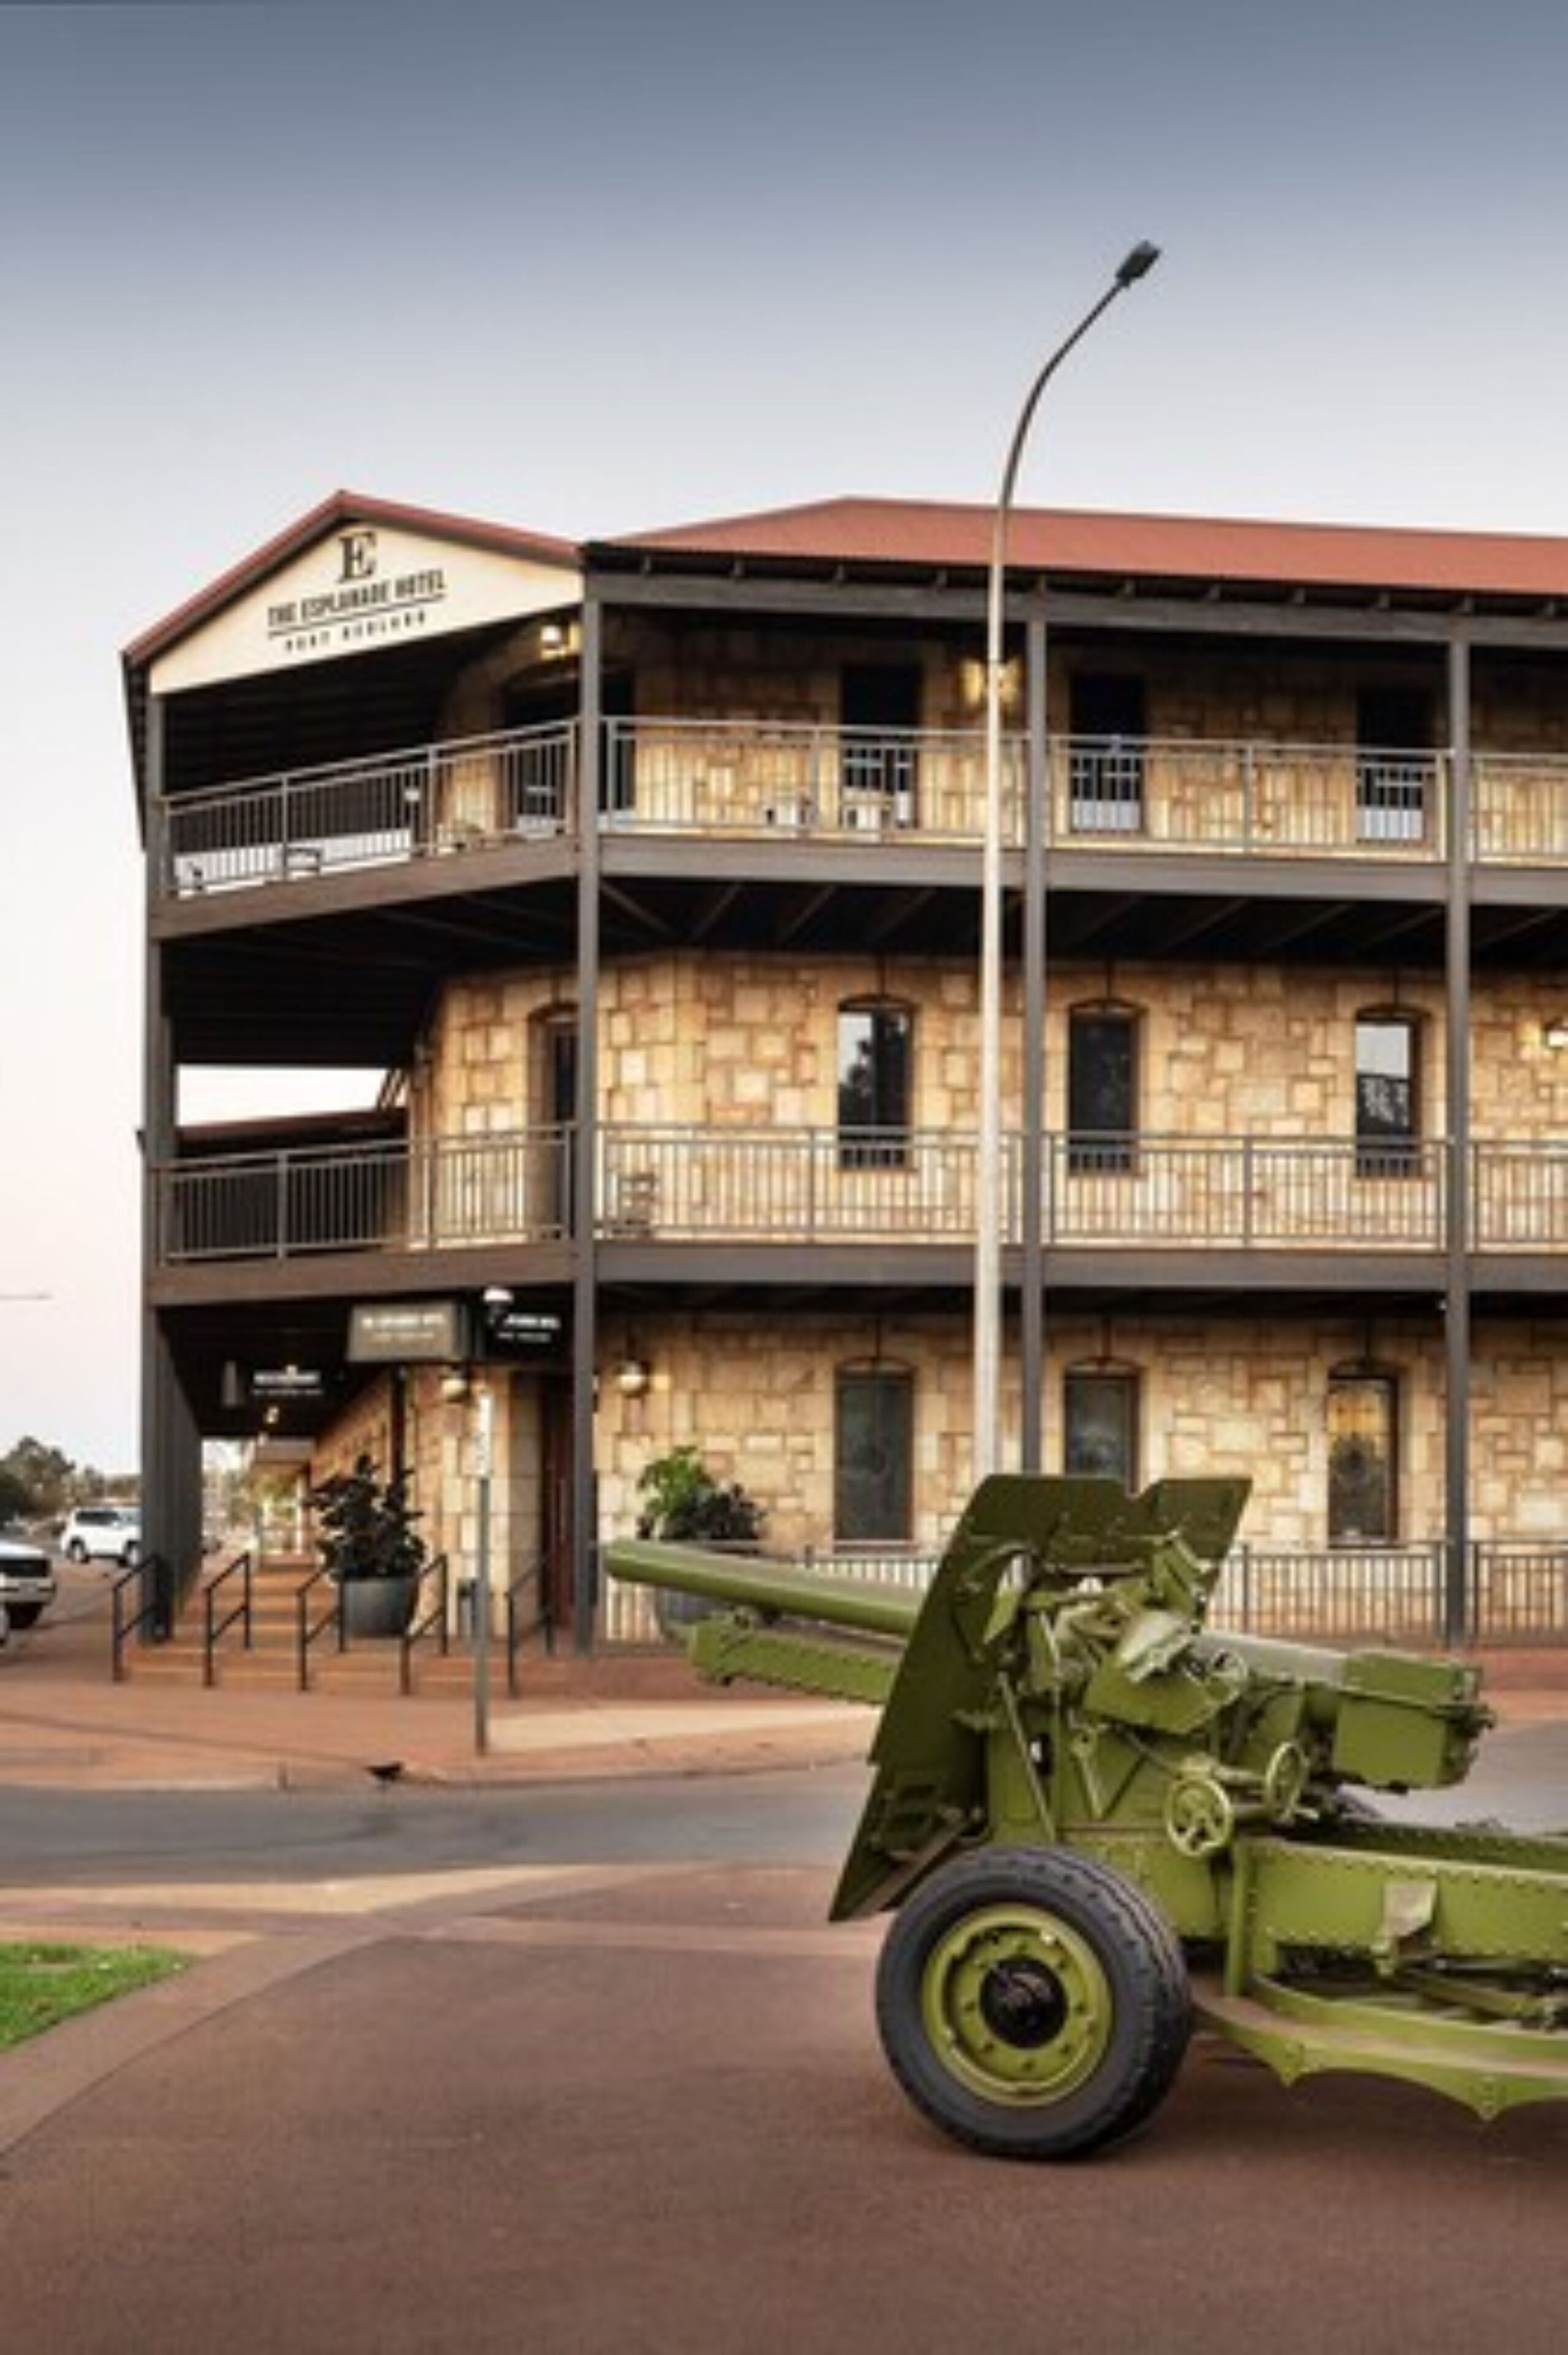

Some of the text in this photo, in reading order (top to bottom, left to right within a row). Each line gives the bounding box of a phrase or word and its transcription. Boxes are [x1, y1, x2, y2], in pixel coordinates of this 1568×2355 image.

[338, 530, 377, 583] E
[267, 602, 297, 627] THE
[395, 569, 446, 599] HOTEL
